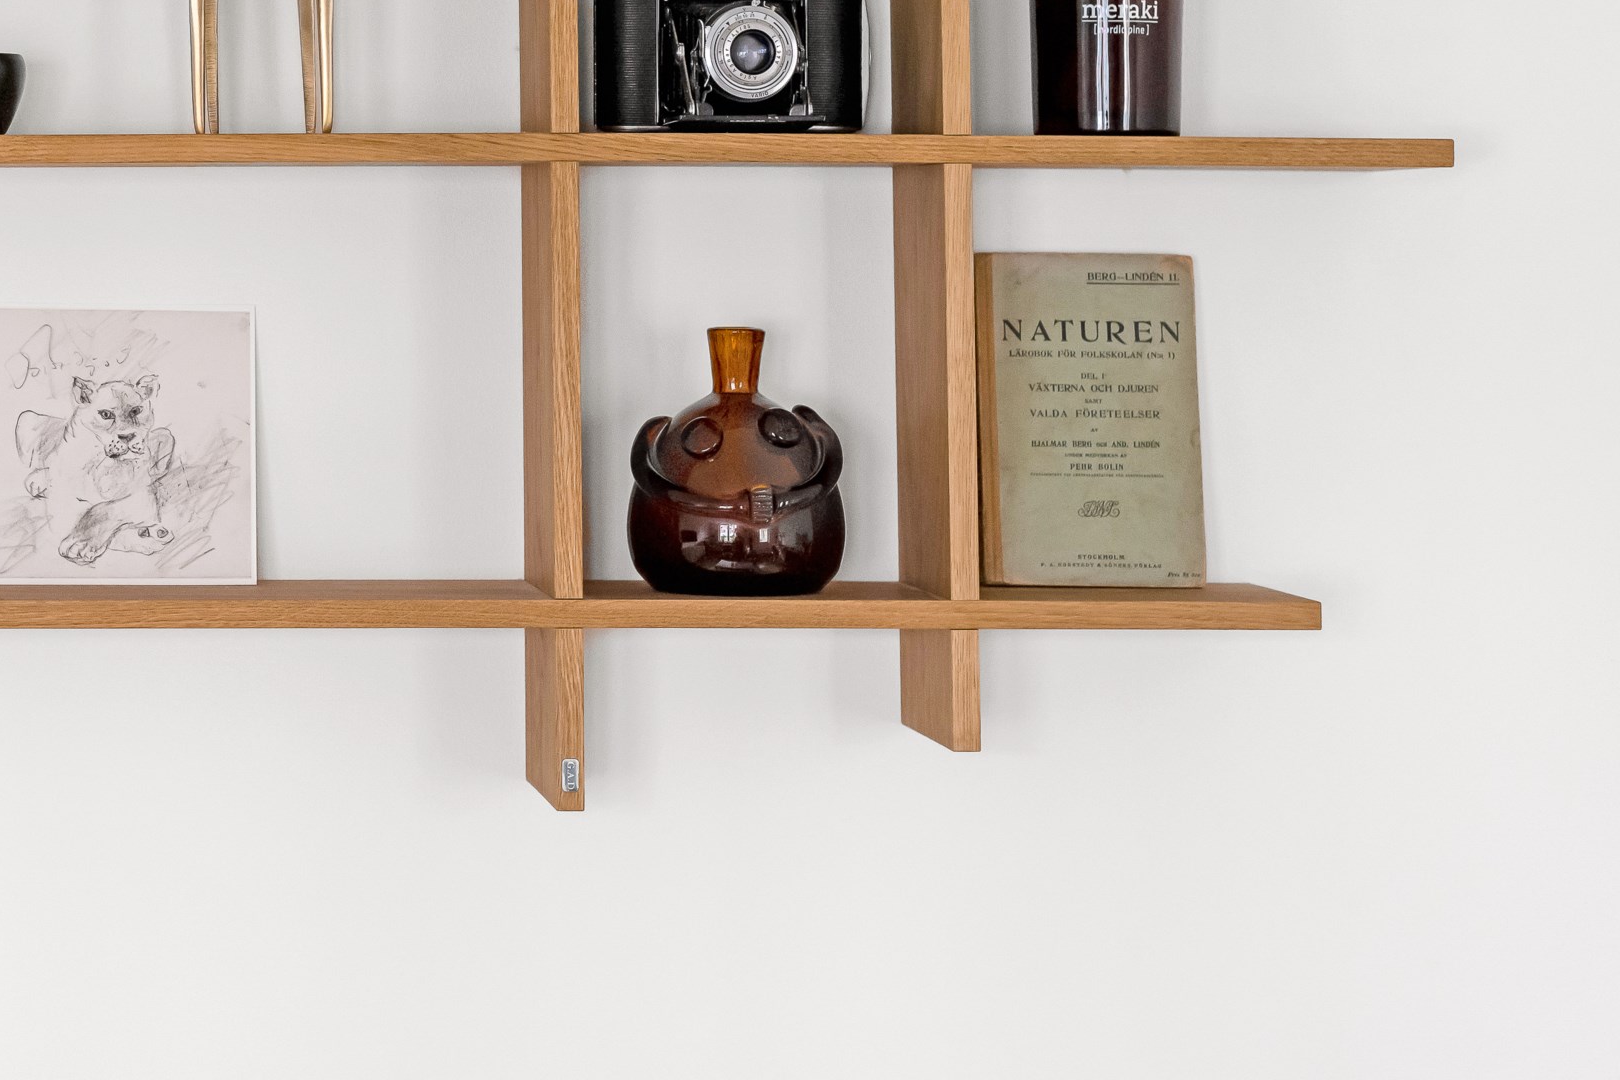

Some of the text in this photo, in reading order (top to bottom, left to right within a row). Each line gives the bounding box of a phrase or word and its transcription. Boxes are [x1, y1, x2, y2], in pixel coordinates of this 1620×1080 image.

[1081, 0, 1159, 20] meraki
[1001, 318, 1181, 345] NATUREN
[1009, 349, 1053, 358] LÄROBOK
[1057, 350, 1077, 358] FÖR
[1080, 351, 1143, 359] FOLKSKOLAN
[1029, 383, 1159, 394] VÄXTERNA OCH DJUREN
[1030, 408, 1160, 419] VALDA FÖRETEELSER
[1031, 440, 1067, 448] HJALMAR
[1072, 440, 1092, 448] BERG
[1133, 440, 1160, 448] LINDÉN
[1098, 463, 1124, 471] BOLIN
